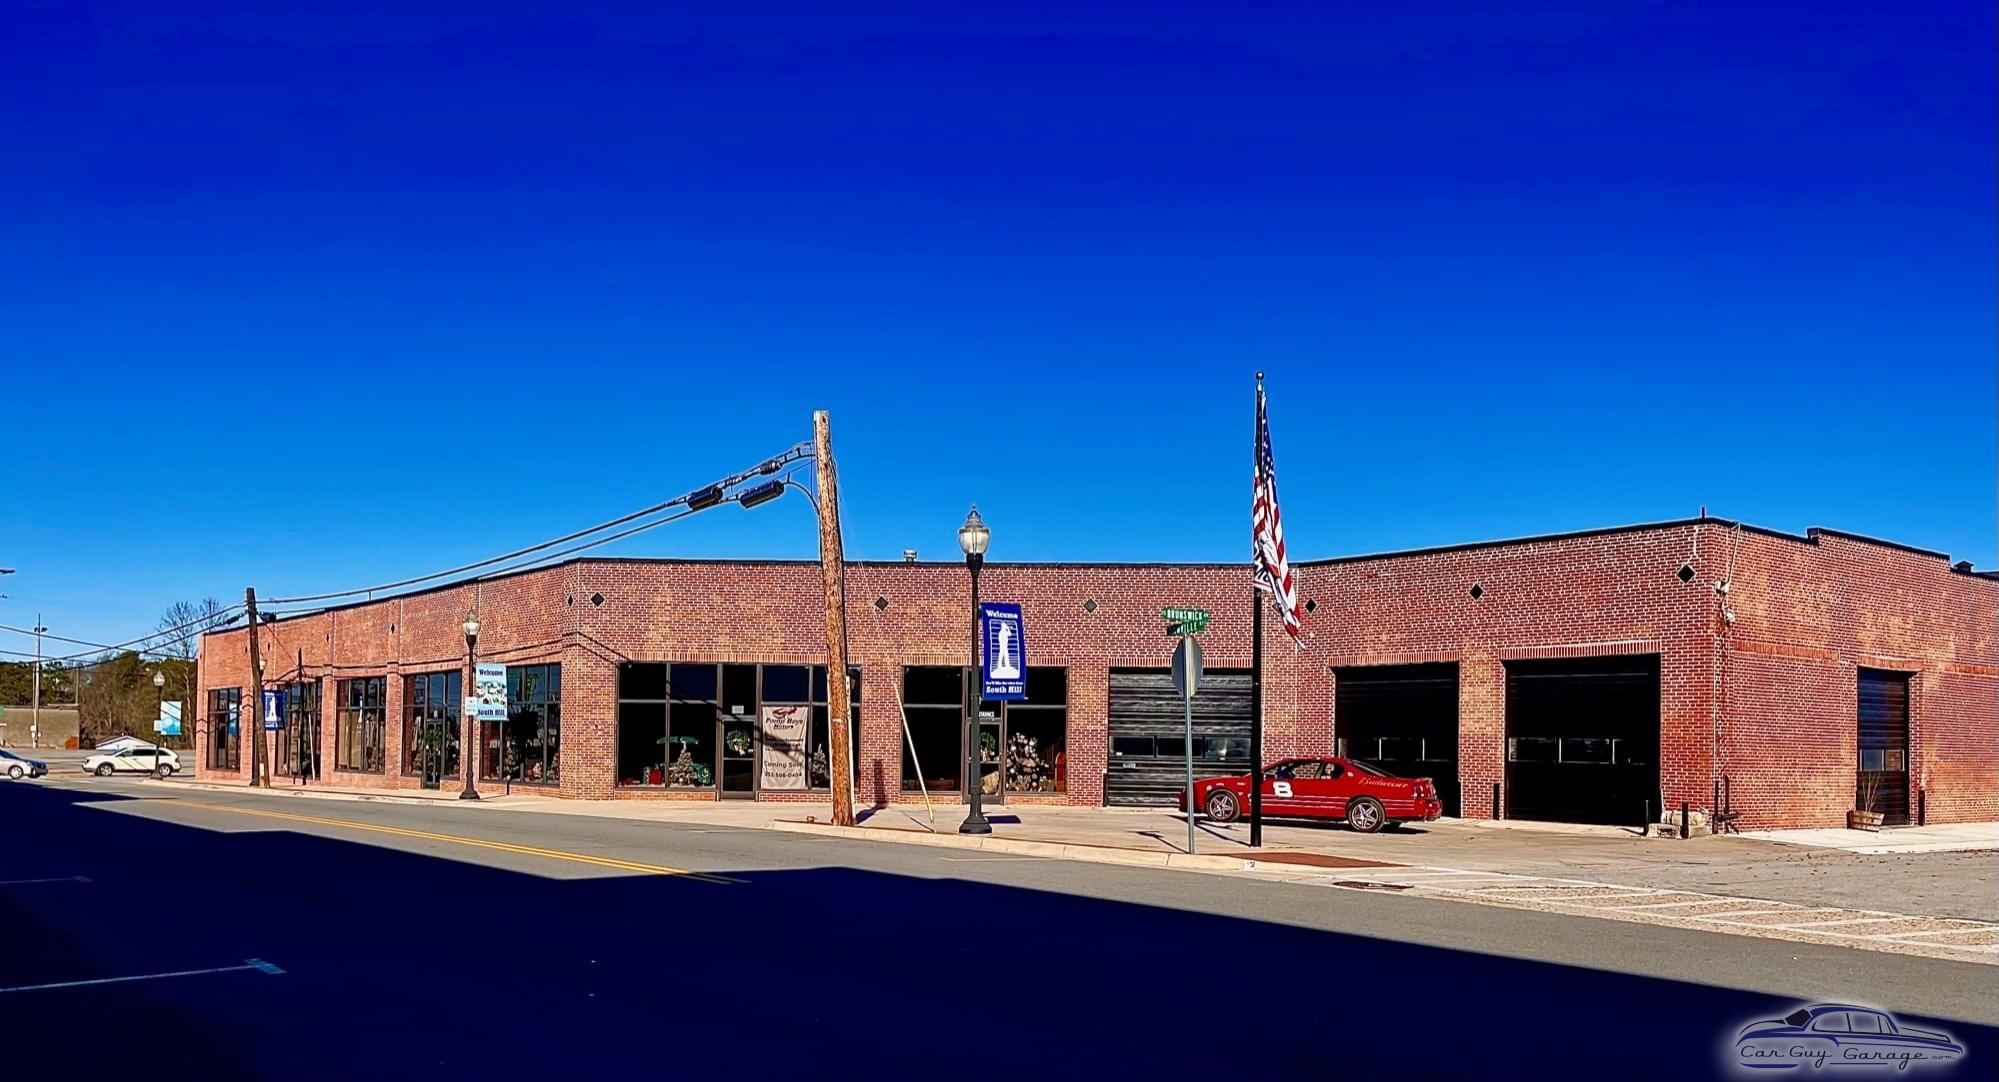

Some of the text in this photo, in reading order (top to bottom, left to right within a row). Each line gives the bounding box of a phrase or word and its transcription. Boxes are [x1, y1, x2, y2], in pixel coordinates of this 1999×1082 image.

[985, 609, 1018, 619] Welcome
[1167, 608, 1203, 621] BRUNSWICK
[986, 686, 1023, 694] South Hill
[764, 760, 787, 768] Coming
[1272, 781, 1294, 798] 8
